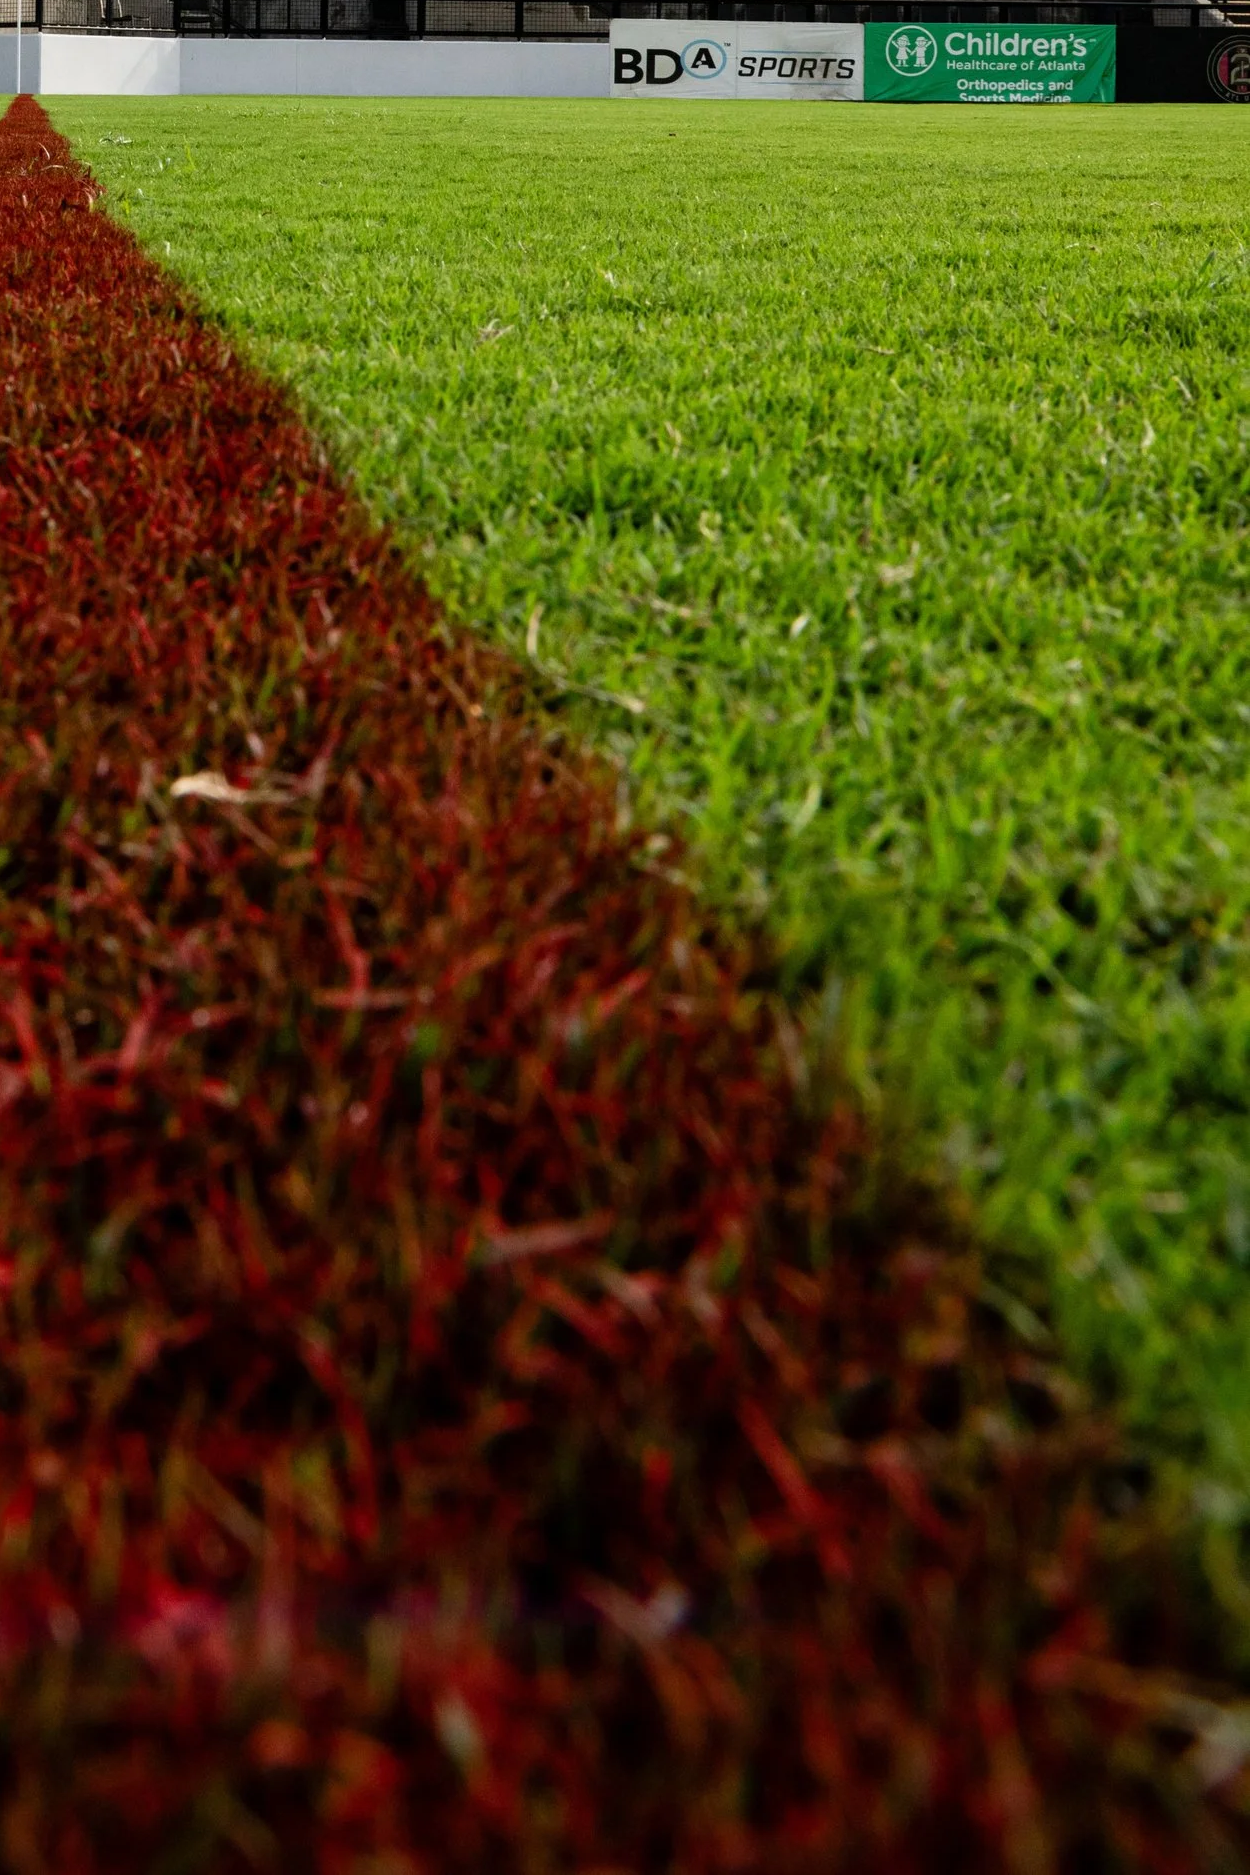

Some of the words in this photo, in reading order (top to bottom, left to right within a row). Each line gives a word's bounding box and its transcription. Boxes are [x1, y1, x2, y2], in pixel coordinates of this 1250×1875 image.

[944, 31, 1088, 57] Children's
[738, 57, 856, 80] SPORTS
[946, 59, 1017, 72] Healthcare
[1020, 59, 1035, 71] of
[1038, 60, 1086, 72] Atlanta
[956, 78, 1044, 93] Orthopedics
[1048, 79, 1074, 90] and
[959, 92, 1006, 102] Sports
[1009, 92, 1071, 103] Medicine
